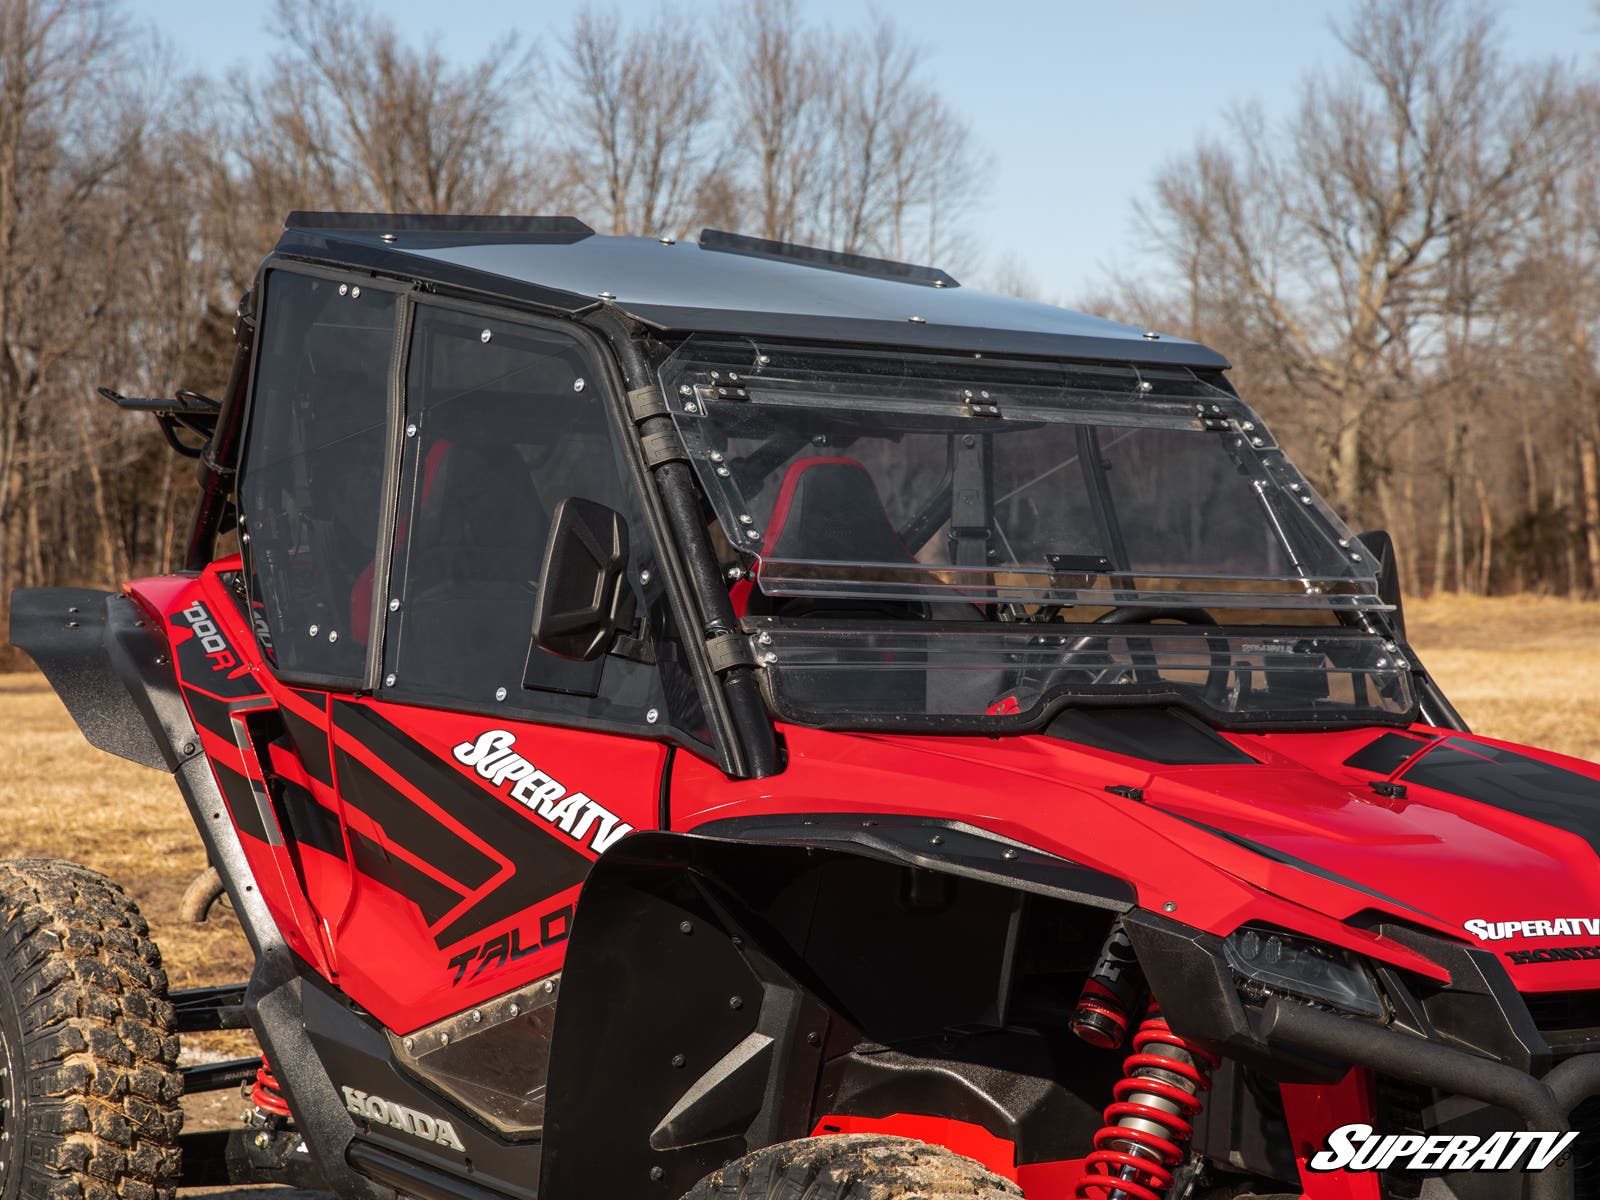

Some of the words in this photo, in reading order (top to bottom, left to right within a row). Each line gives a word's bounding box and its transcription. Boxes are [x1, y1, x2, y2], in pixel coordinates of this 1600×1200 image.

[448, 901, 577, 987] TALO
[1464, 918, 1600, 941] SUPERATV
[1504, 945, 1600, 965] HOND
[341, 1085, 466, 1153] HONDA
